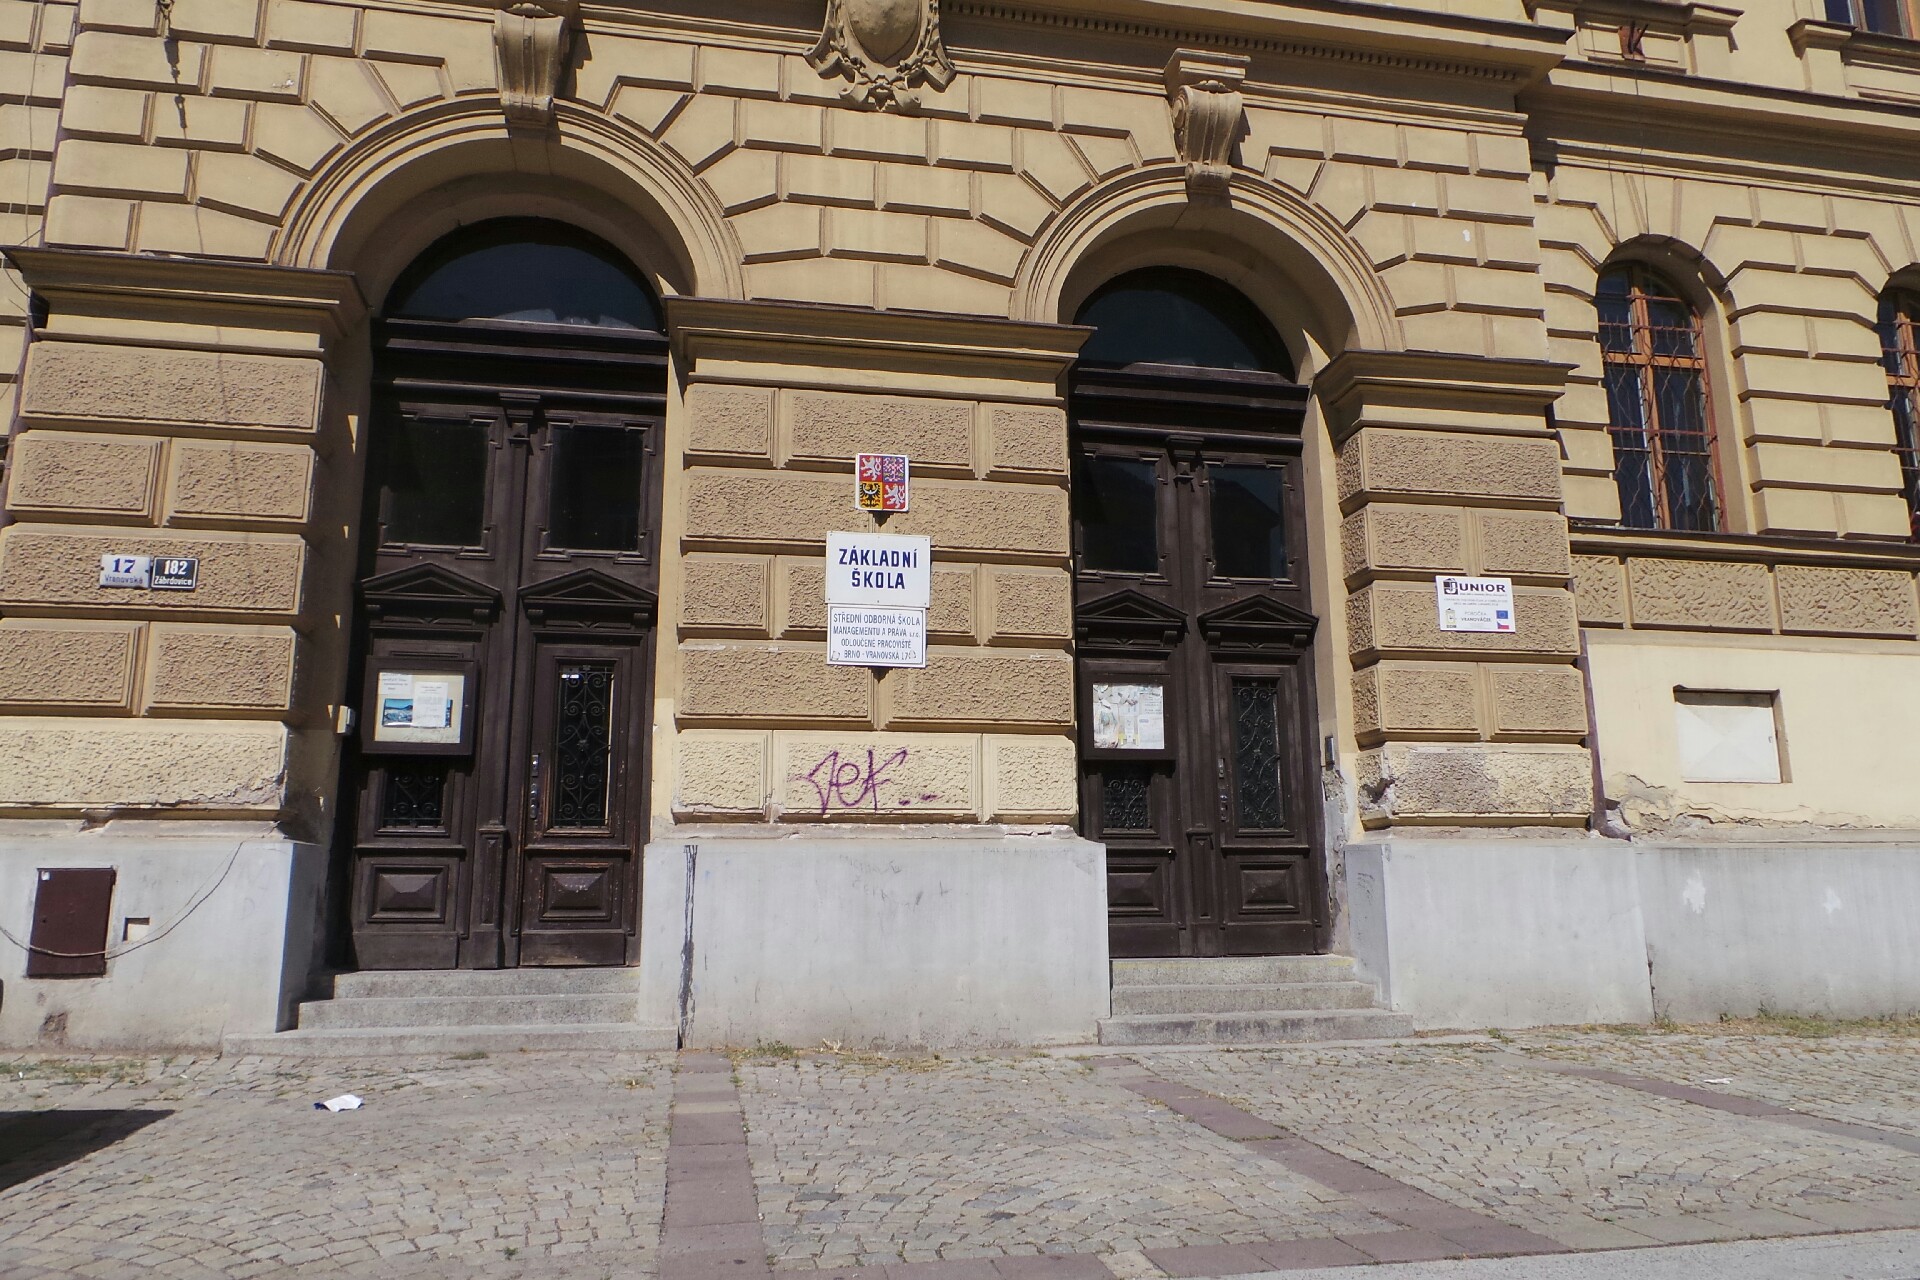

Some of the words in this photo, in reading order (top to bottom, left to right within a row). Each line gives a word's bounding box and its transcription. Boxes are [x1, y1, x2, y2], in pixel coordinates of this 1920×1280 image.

[839, 545, 917, 568] ZÁKLADNÍ
[113, 558, 135, 573] 17
[164, 560, 187, 575] 182
[851, 568, 905, 589] ŠKOLA
[833, 612, 862, 623] STŘEDNÍ
[864, 614, 896, 625] ODBORNÁ
[898, 614, 921, 626] ŠKOLA
[833, 625, 880, 635] MANAGEMENTU
[882, 628, 886, 636] A
[887, 627, 907, 637] PRÁVA
[841, 638, 876, 648] ODLOUČENÉ
[877, 639, 911, 649] PRACOVIŠTĚ
[844, 650, 861, 659] BRNO
